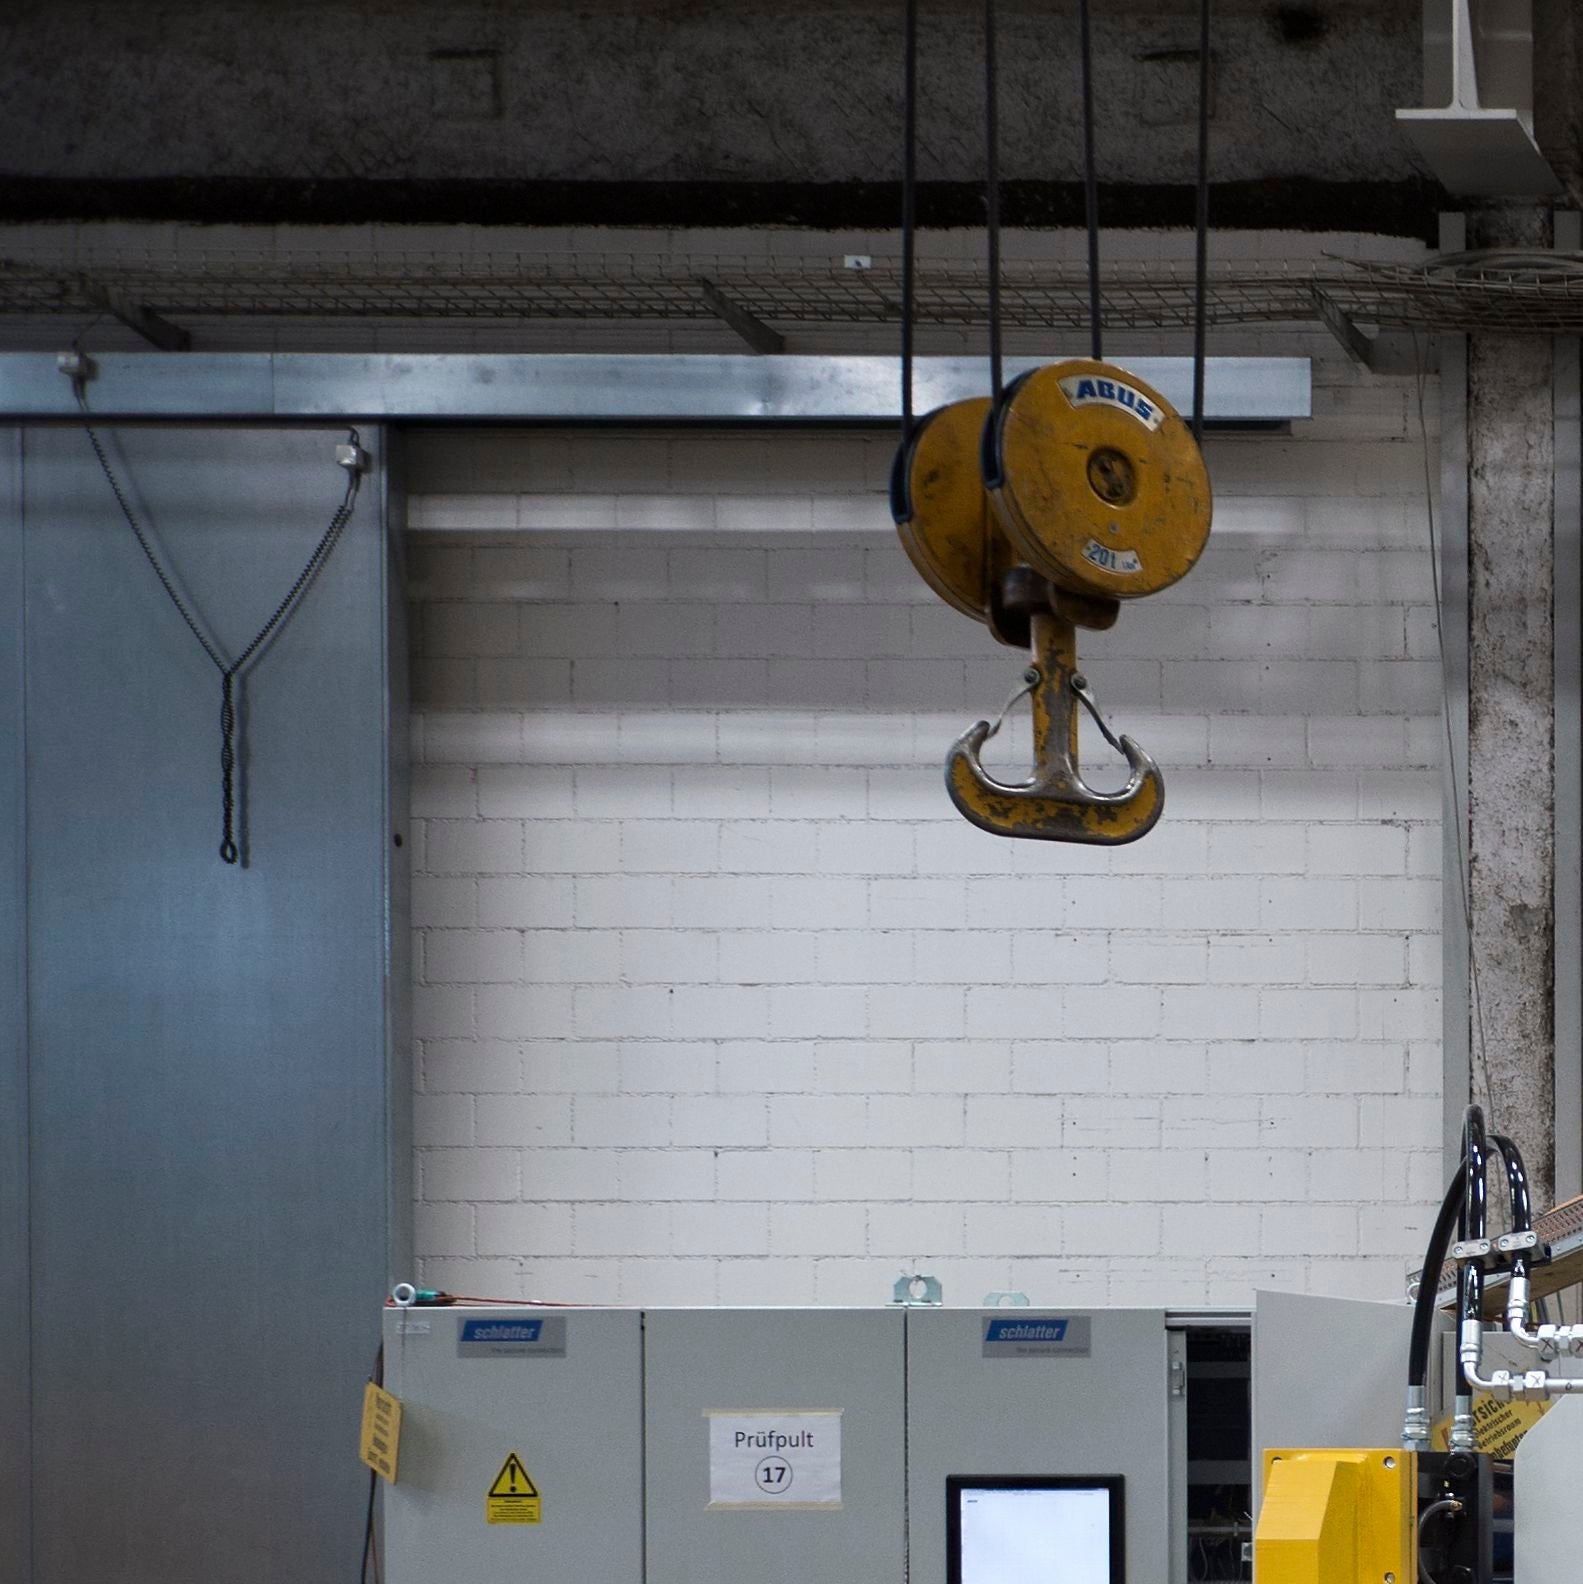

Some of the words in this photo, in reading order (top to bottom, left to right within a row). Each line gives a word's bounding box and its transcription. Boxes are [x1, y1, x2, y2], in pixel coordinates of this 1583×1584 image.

[1077, 379, 1153, 421] ABUS
[474, 1325, 537, 1340] schlatter
[999, 1324, 1061, 1340] schlatter
[735, 1430, 814, 1452] Prüfpult
[763, 1466, 786, 1484] 17
